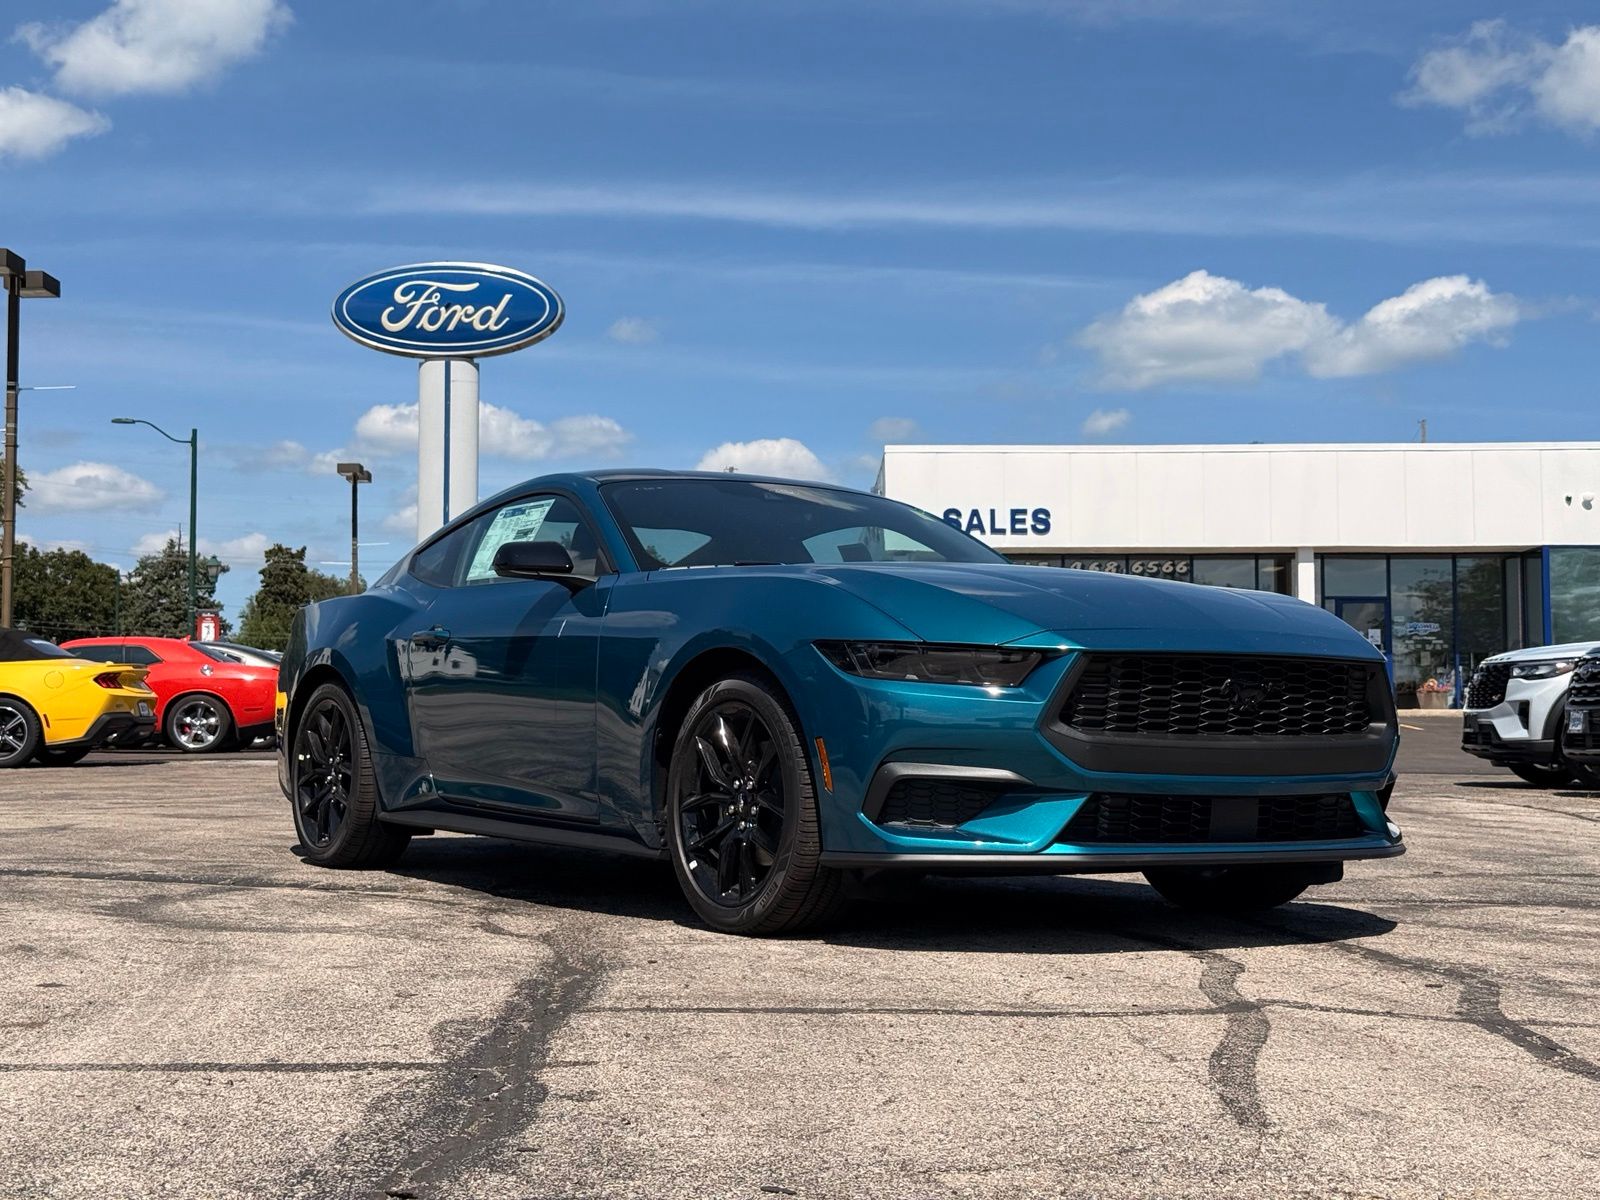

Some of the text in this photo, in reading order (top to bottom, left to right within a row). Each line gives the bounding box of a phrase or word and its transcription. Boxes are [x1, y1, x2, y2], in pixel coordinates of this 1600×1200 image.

[381, 280, 513, 332] Ford
[943, 507, 1051, 535] SALES
[1131, 560, 1188, 574] 6566
